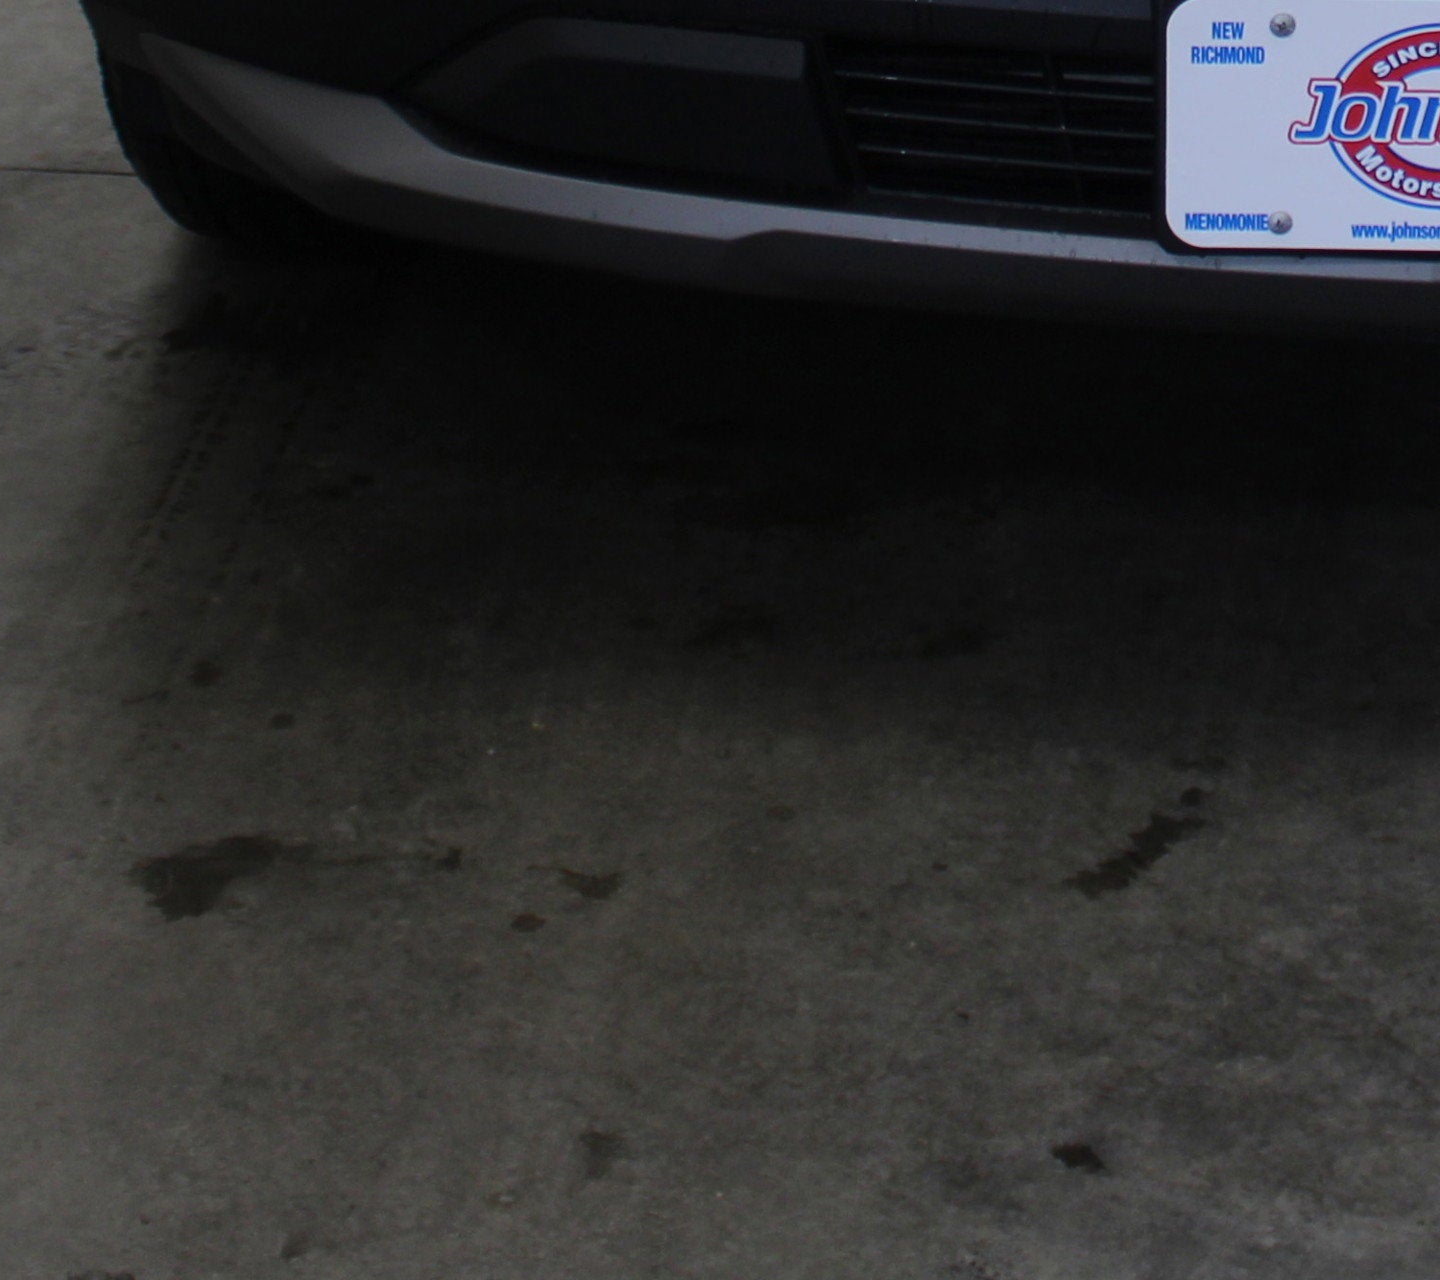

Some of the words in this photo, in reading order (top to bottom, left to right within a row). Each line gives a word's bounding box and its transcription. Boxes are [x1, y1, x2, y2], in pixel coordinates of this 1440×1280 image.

[1212, 22, 1244, 40] NEW
[1190, 46, 1265, 65] RICHMOND
[1185, 212, 1270, 232] MENOMONIE
